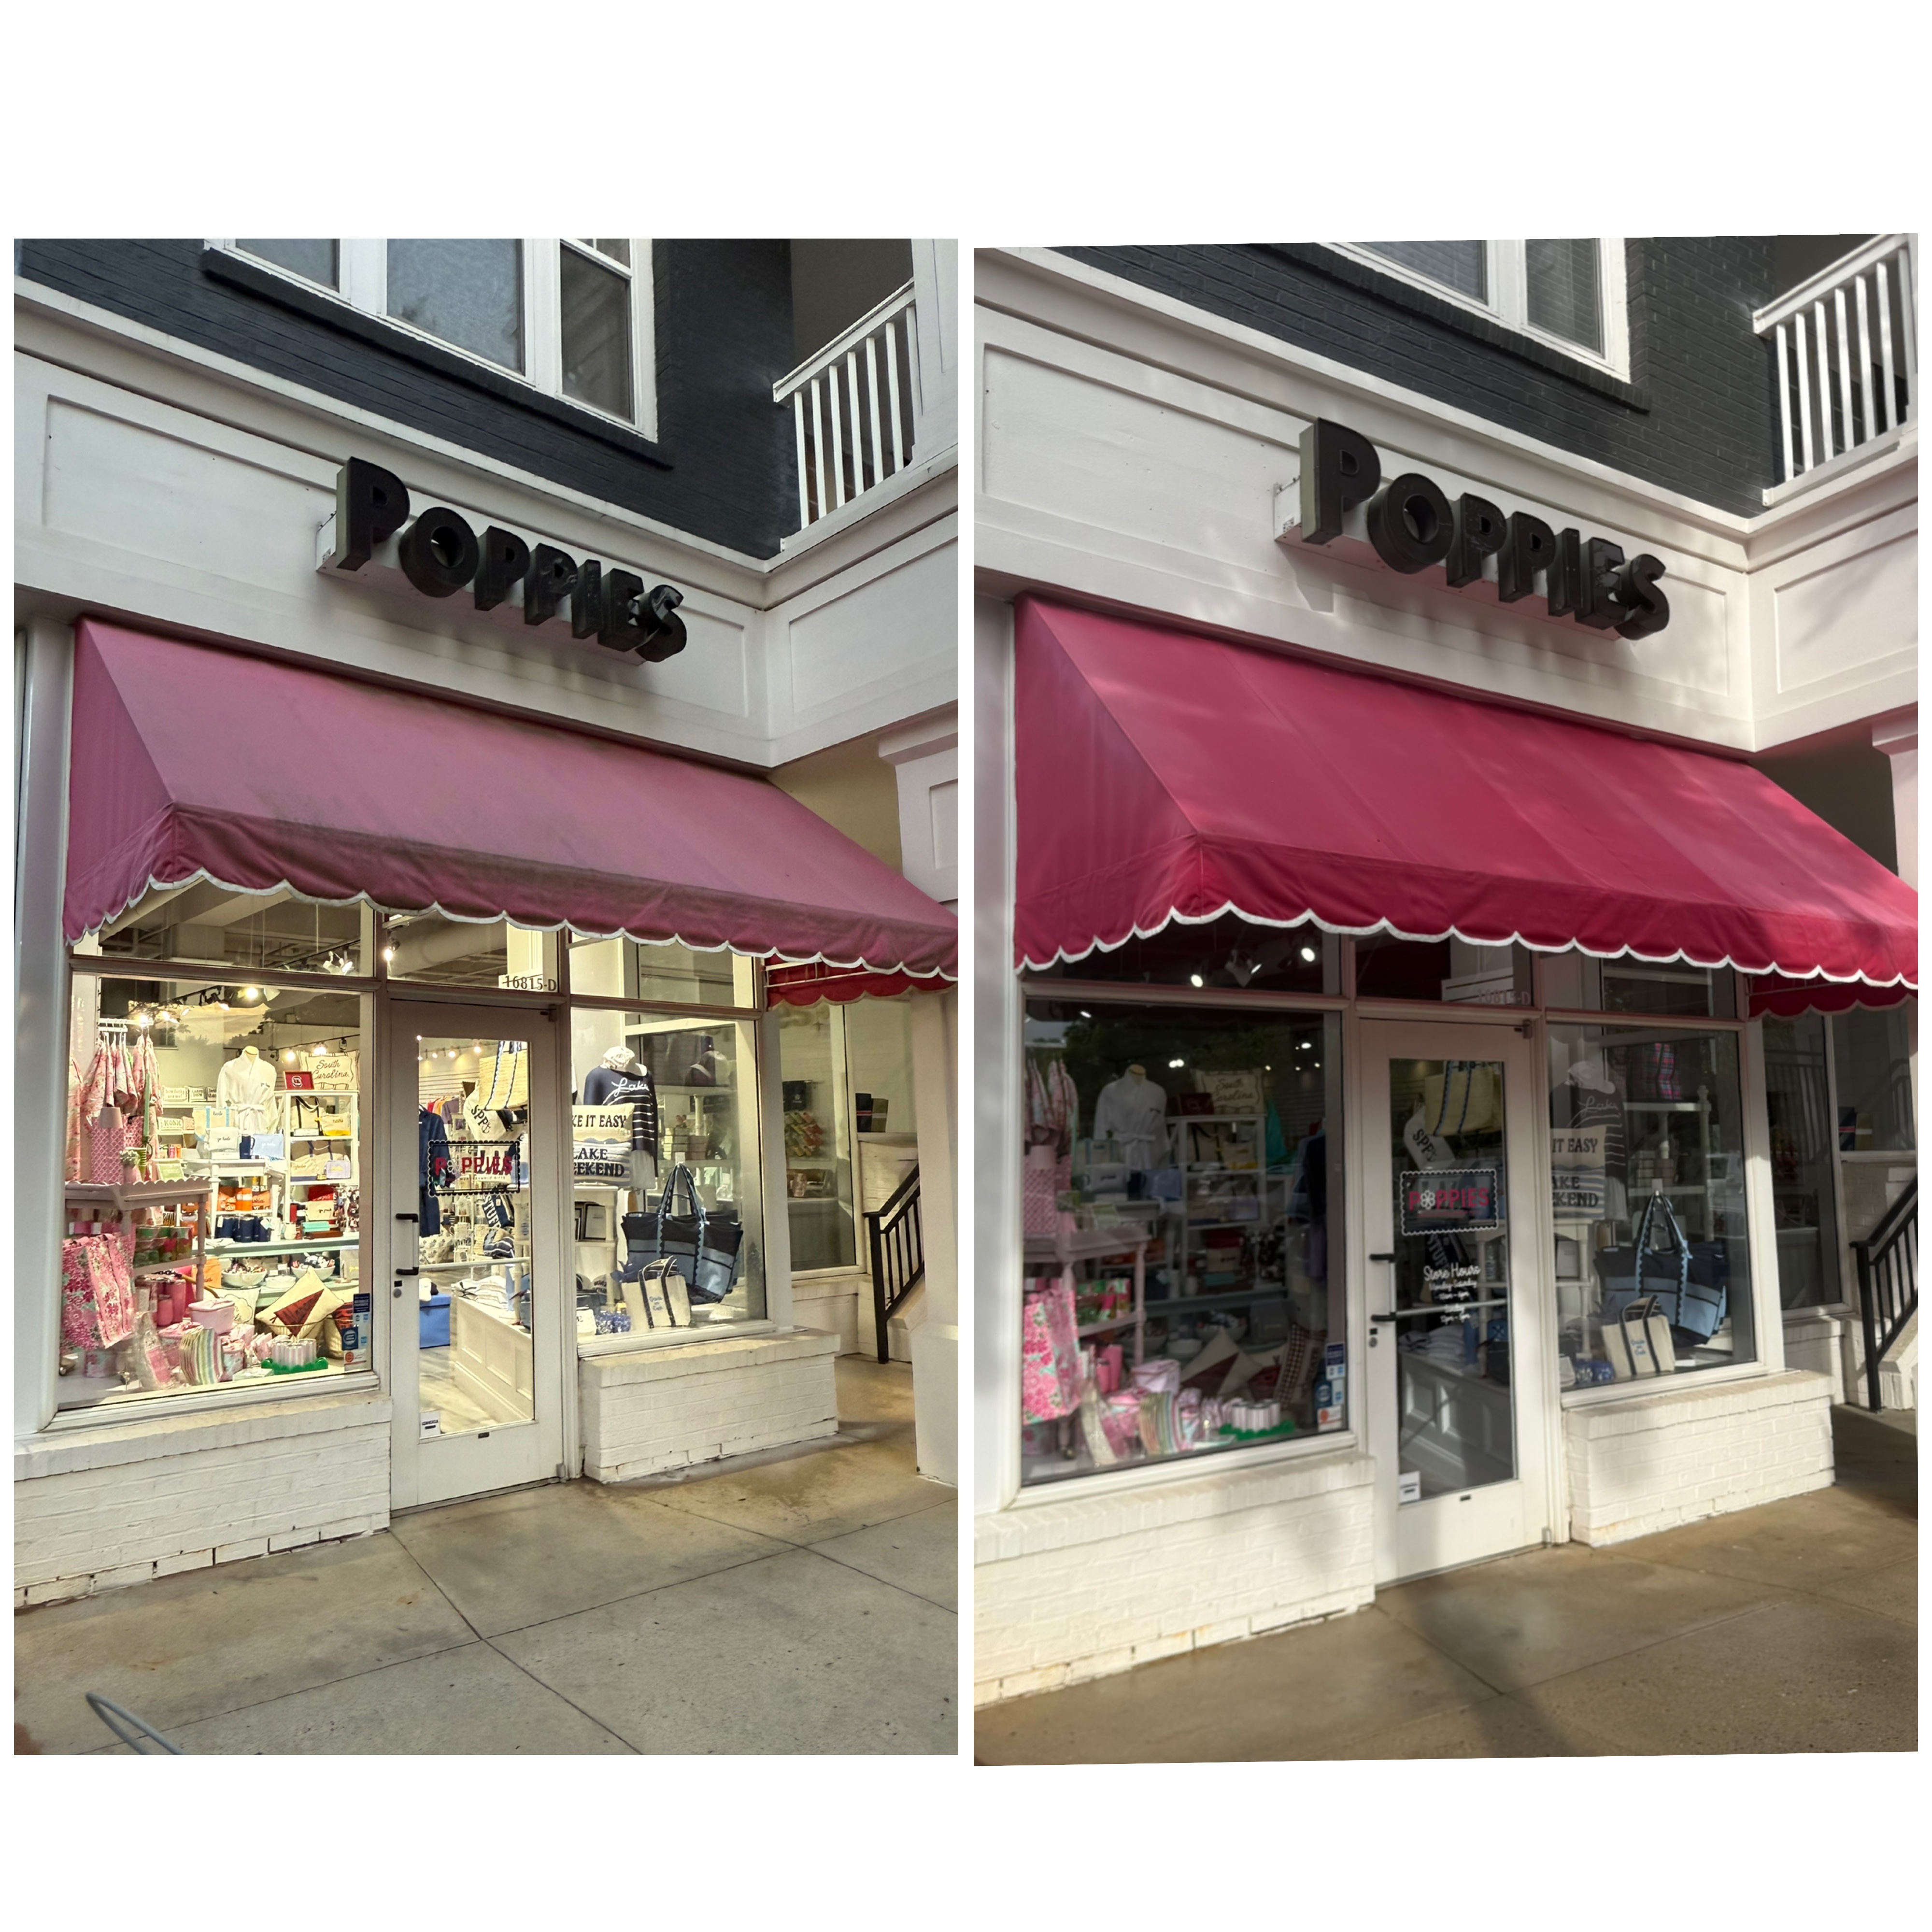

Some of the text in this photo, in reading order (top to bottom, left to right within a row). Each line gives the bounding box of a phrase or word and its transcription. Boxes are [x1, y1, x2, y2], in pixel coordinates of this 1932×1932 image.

[1300, 417, 1670, 640] POPPIES
[336, 456, 687, 662] POPPIES
[505, 975, 556, 992] 16815-D
[316, 1059, 341, 1070] South
[586, 1115, 596, 1127] IT
[599, 1115, 627, 1128] EASY
[1568, 1138, 1598, 1153] EASY
[1450, 1262, 1481, 1278] Hours
